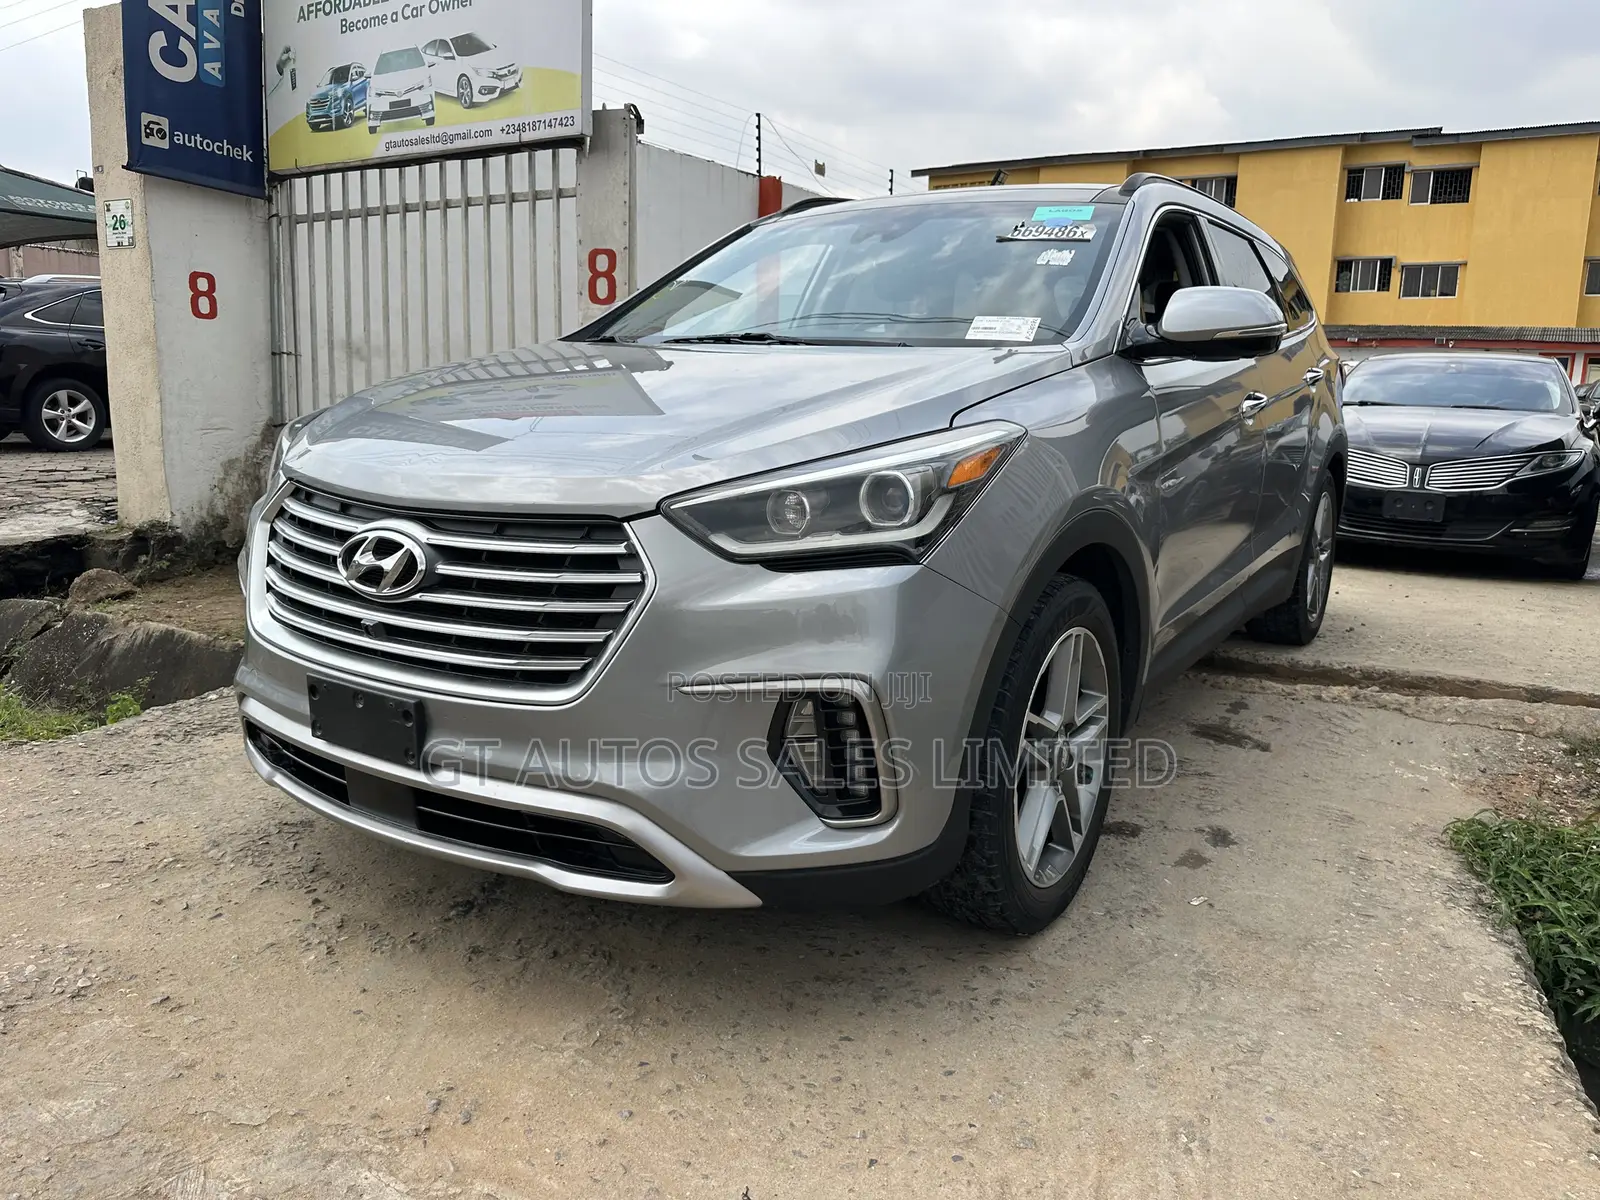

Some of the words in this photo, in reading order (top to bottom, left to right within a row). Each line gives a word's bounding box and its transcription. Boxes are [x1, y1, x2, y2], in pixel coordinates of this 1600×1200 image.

[297, 0, 390, 23] AFFORDA
[340, 13, 388, 34] Become
[391, 11, 398, 23] a
[401, 4, 425, 20] Car
[429, 0, 472, 14] Owner
[173, 131, 254, 162] autochek
[384, 128, 493, 151] gtautosalesltd@gmail.com
[500, 115, 576, 135] +2348187147423
[111, 214, 126, 231] 26
[588, 247, 617, 305] 8
[189, 270, 218, 319] 8
